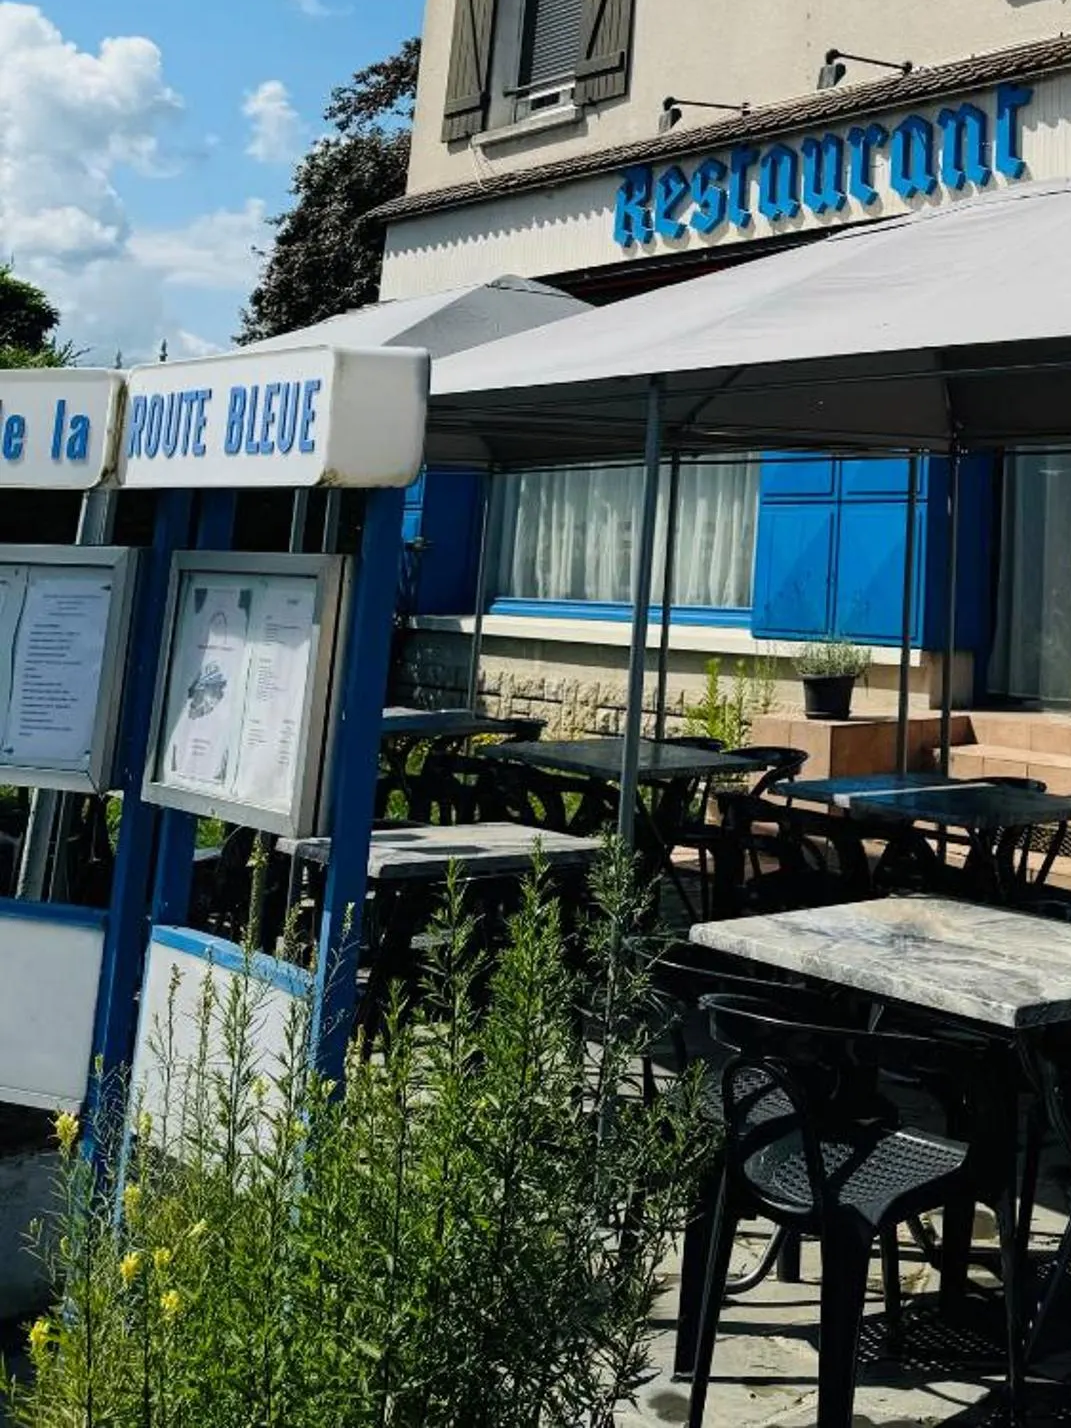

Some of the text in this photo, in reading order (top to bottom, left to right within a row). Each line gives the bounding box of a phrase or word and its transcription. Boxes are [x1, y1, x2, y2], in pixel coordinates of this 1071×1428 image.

[613, 83, 1033, 249] Restaurant
[0, 379, 322, 461] e la ROUTE BLEUE
